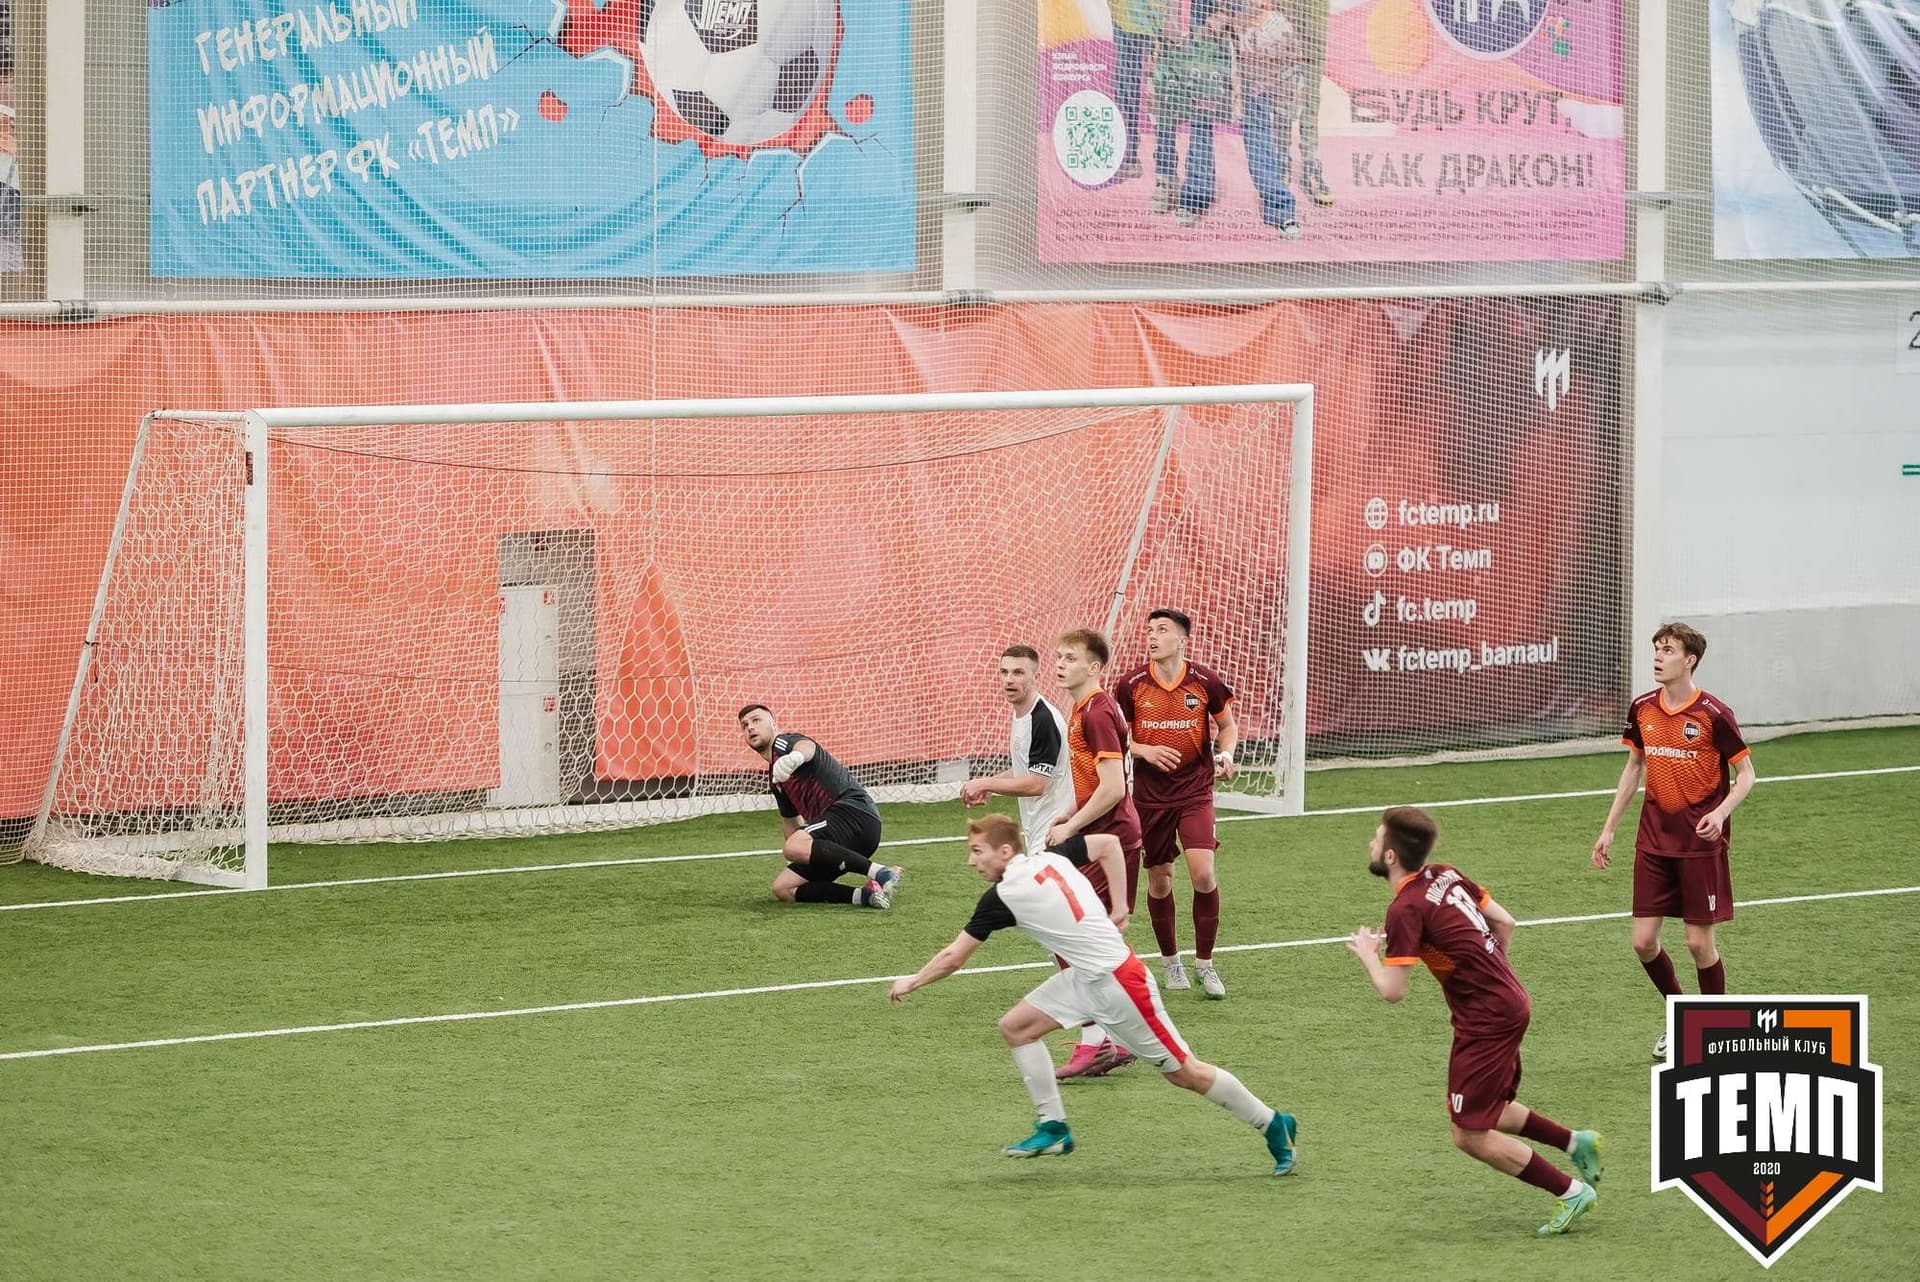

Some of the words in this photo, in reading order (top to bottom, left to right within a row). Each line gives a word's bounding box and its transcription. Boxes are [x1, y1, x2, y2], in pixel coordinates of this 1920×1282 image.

[198, 26, 498, 154] ИНФОРМАЦИОННЫЙ
[1351, 88, 1466, 132] БУДЬ
[197, 149, 338, 225] ПАРТНЕР
[346, 131, 400, 184] ФК
[408, 103, 521, 165] «ТЕМП»
[1351, 153, 1426, 188] КАК
[1436, 153, 1594, 196] ДРАКОН!
[1398, 500, 1500, 529] fctemp.ru
[1397, 546, 1432, 573] ФК
[1435, 544, 1492, 570] Темп
[1396, 595, 1477, 625] fc.temp
[1397, 636, 1558, 675] fctemp_barnaul
